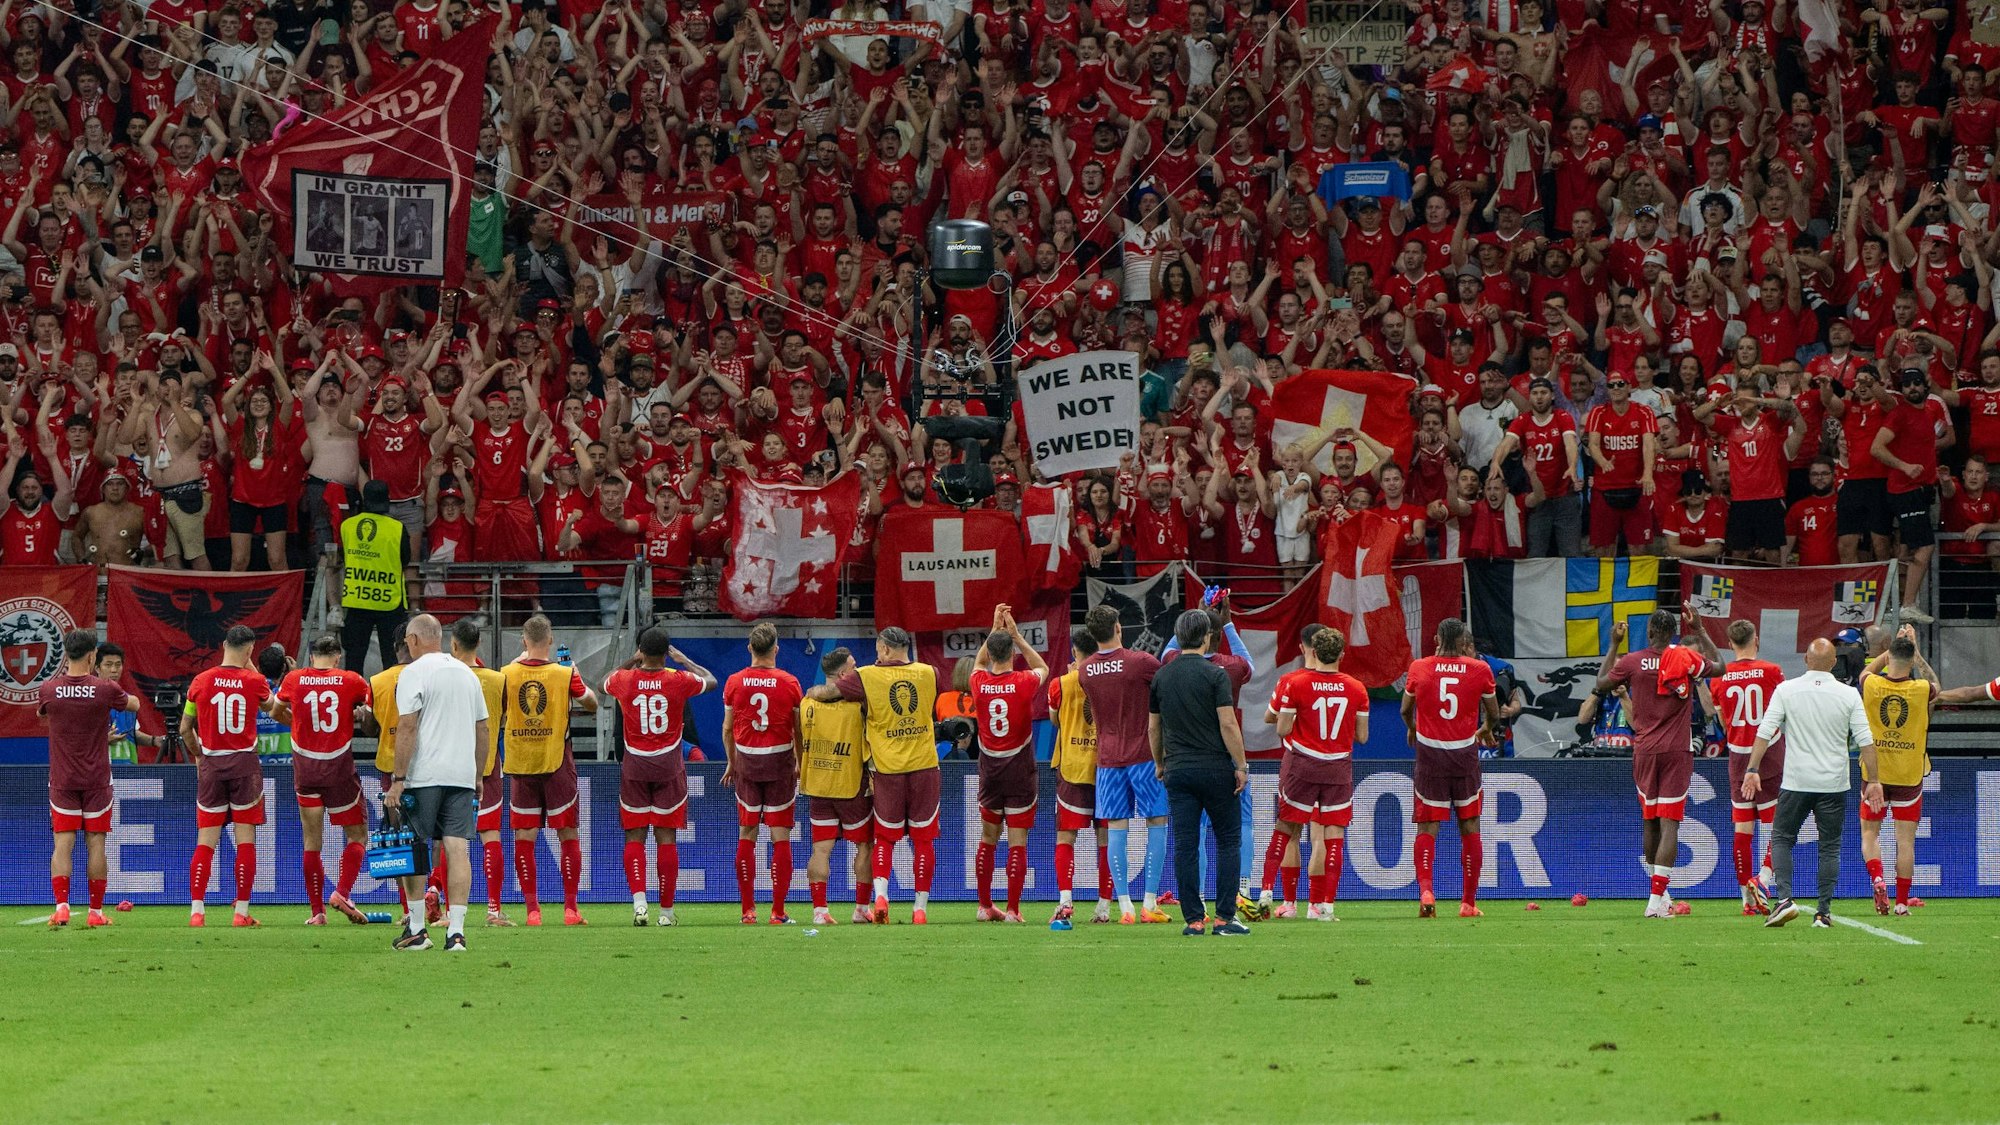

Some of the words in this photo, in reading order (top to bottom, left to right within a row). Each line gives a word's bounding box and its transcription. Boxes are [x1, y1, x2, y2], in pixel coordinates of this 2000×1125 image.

[1309, 4, 1401, 22] AKANJI
[416, 24, 429, 40] 11
[1311, 26, 1341, 42] TON
[1349, 24, 1405, 42] MAILLOT
[221, 65, 233, 79] 17
[146, 94, 160, 110] 10
[314, 177, 336, 192] IN
[344, 181, 426, 198] GRANIT
[1235, 180, 1250, 197] 10
[1082, 209, 1099, 223] 23
[314, 253, 346, 268] WE
[353, 256, 425, 273] TRUST
[1029, 368, 1070, 394] WE
[1080, 362, 1133, 383] ARE
[1057, 395, 1114, 420] NOT
[1983, 402, 1998, 415] 22
[385, 437, 404, 452] 23
[797, 432, 806, 448] 3
[1603, 434, 1639, 451] SUISSE
[1742, 440, 1758, 457] 10
[493, 450, 502, 465] 6
[1535, 443, 1554, 462] 22
[1802, 515, 1817, 531] 14
[25, 535, 34, 552] 5
[1157, 528, 1165, 545] 6
[649, 540, 668, 558] 23
[909, 556, 990, 571] LAUSANNE
[345, 567, 397, 584] EWARD
[946, 626, 1045, 651] GENVE
[1086, 659, 1124, 677] SUISSE
[1435, 662, 1467, 673] AKANJI
[1641, 658, 1660, 671] SUI
[214, 677, 243, 688] XHAKA
[299, 676, 343, 686] RODRIGUEZ
[743, 677, 777, 688] WIDMER
[1722, 669, 1764, 682] AEBISCHER
[56, 685, 97, 698] SUISSE
[638, 680, 662, 690] DUAH
[980, 684, 1016, 694] FREULER
[1311, 682, 1344, 692] VARGAS
[1439, 677, 1459, 720] 5
[1726, 683, 1763, 727] 20
[210, 691, 246, 735] 10
[303, 690, 340, 733] 13
[632, 693, 669, 735] 18
[750, 692, 769, 732] 3
[988, 698, 1009, 737] 8
[1312, 696, 1349, 740] 17
[512, 728, 553, 738] EURO2024
[886, 725, 928, 738] EURO2024
[260, 735, 280, 753] TV
[813, 761, 842, 769] RESPECT
[370, 858, 407, 869] POWERADE
